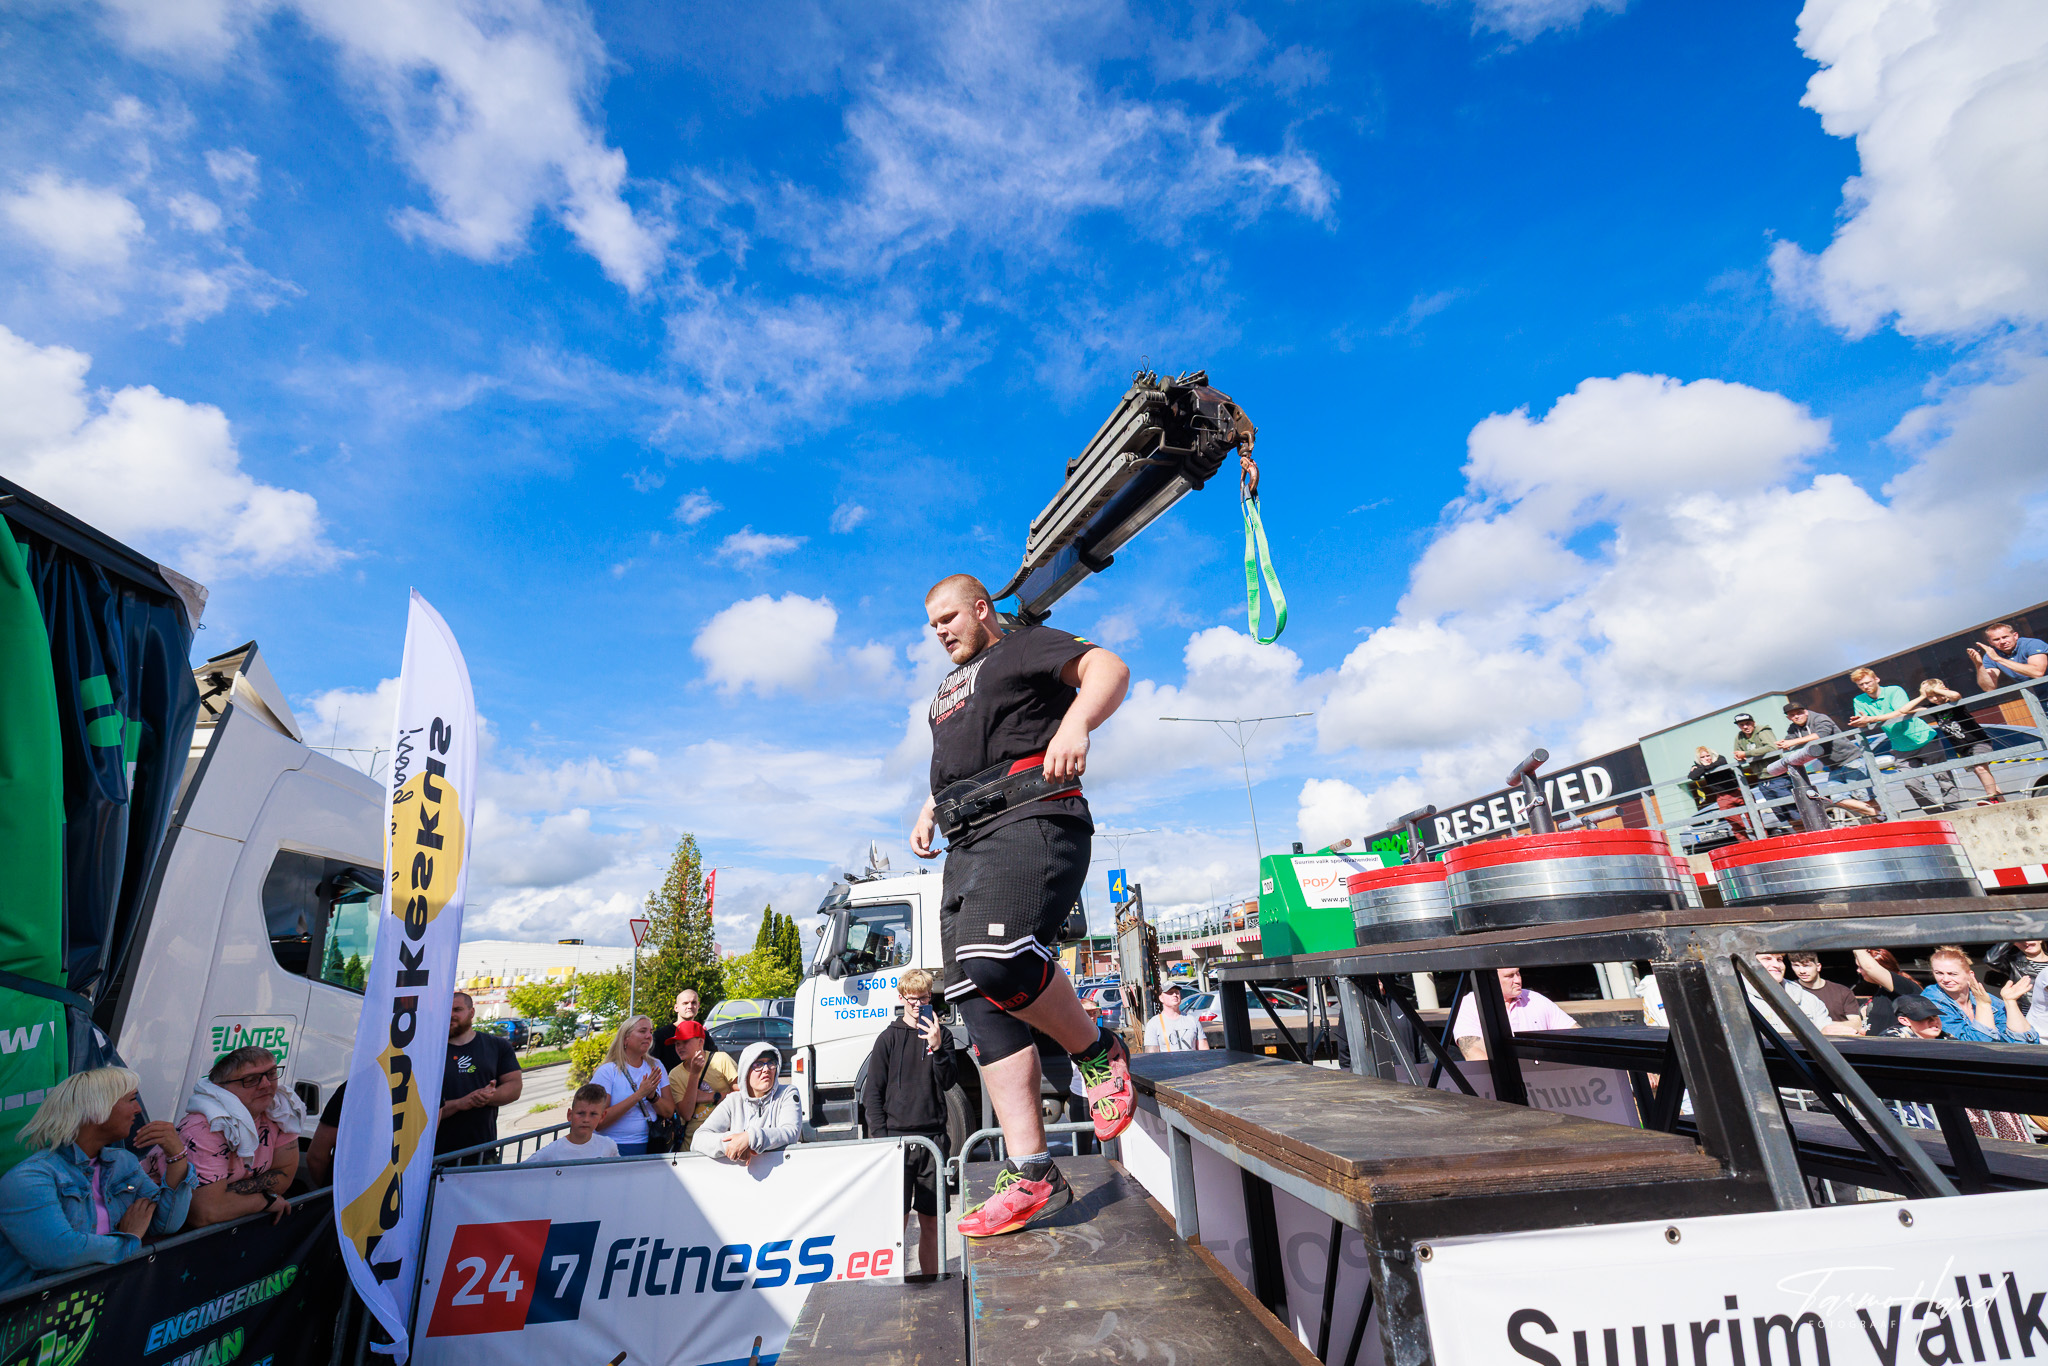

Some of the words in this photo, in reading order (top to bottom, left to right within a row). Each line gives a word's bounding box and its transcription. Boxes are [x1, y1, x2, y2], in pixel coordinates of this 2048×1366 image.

[1113, 878, 1124, 894] 4
[1303, 878, 1329, 888] POP
[857, 977, 887, 991] 5560
[890, 976, 902, 989] 9
[820, 995, 859, 1007] GENNO
[835, 1007, 888, 1020] TÕSTEABI
[452, 1254, 524, 1307] 24
[550, 1254, 580, 1299] 7
[145, 1265, 298, 1355] ENGINEERING
[1506, 1294, 1831, 1366] Suurim
[1855, 1270, 2048, 1366] valik
